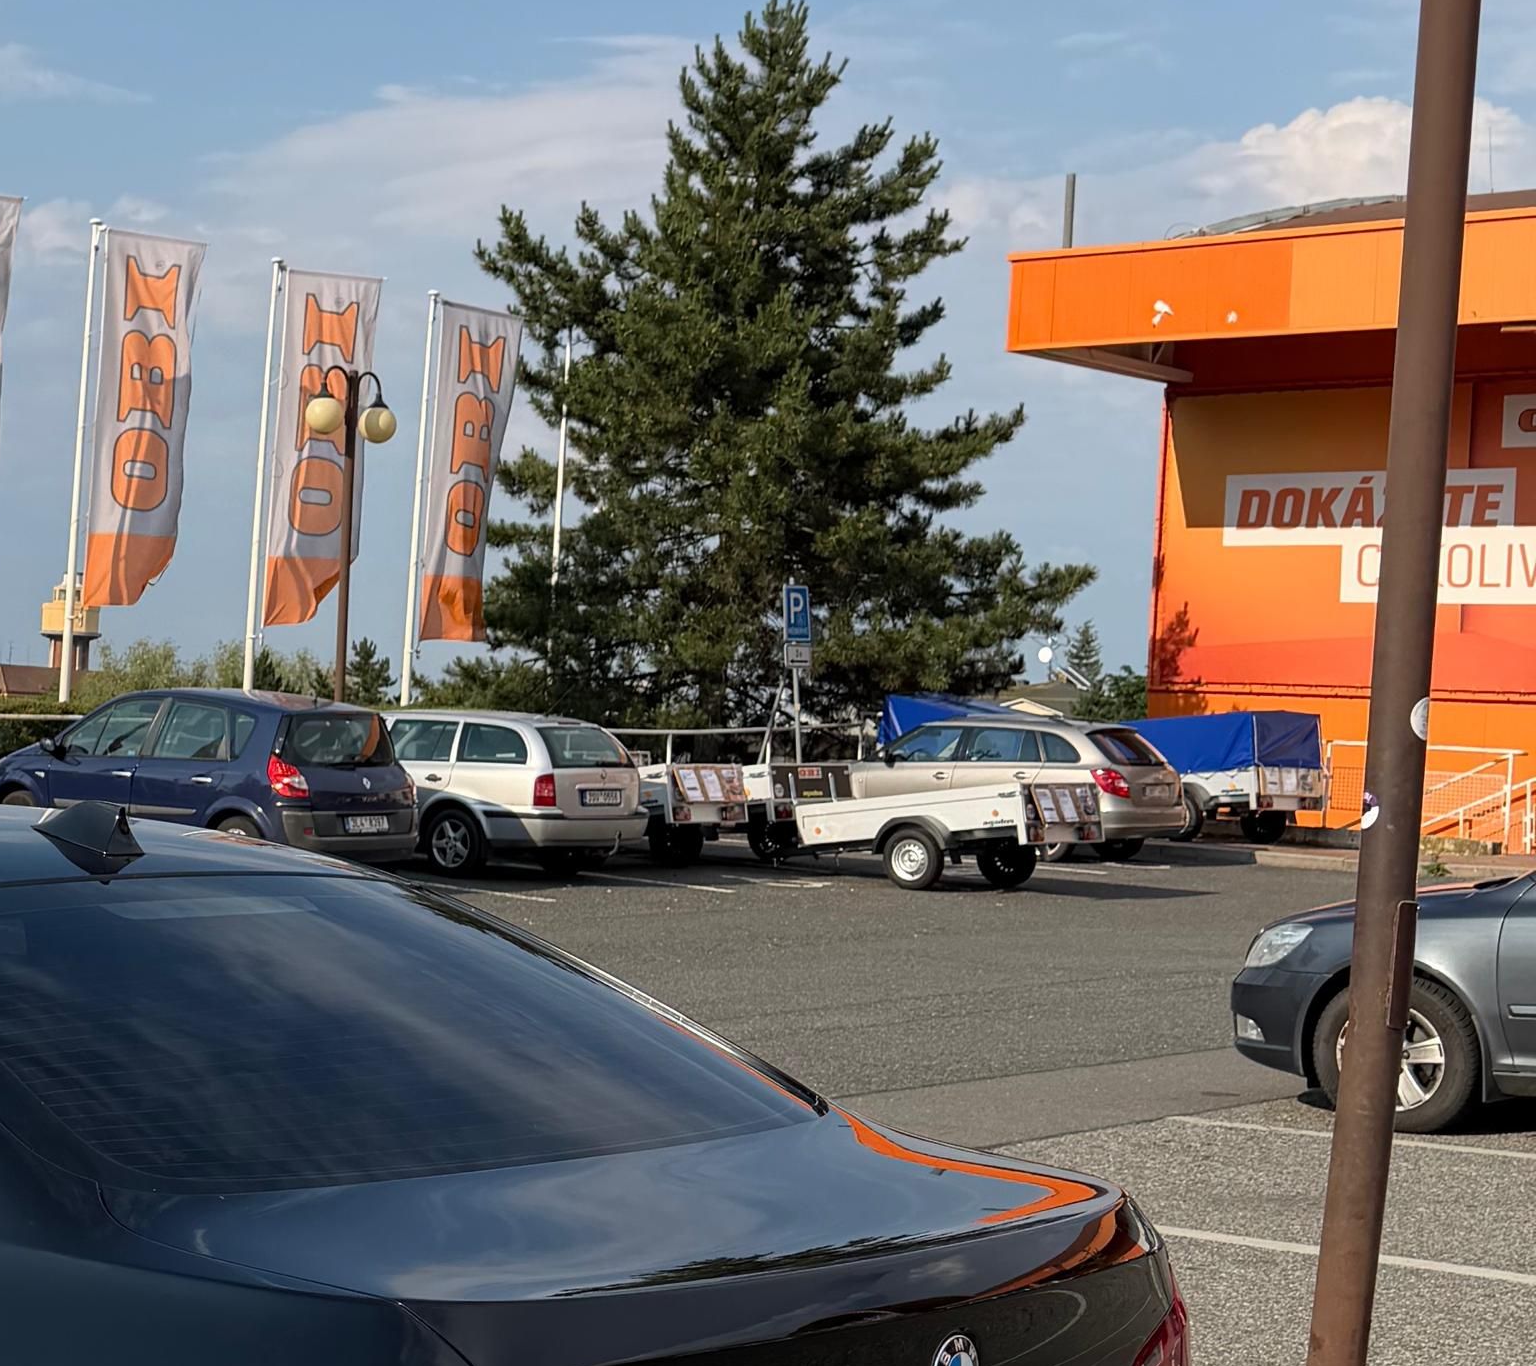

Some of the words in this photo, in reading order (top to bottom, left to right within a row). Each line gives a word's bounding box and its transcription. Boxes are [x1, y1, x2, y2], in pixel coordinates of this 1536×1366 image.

[110, 255, 182, 512] OBI
[444, 325, 507, 557] OBI
[1236, 476, 1505, 529] DOKÁTE
[1357, 543, 1536, 588] COLIV
[789, 592, 804, 624] P
[939, 1337, 977, 1366] BMW
